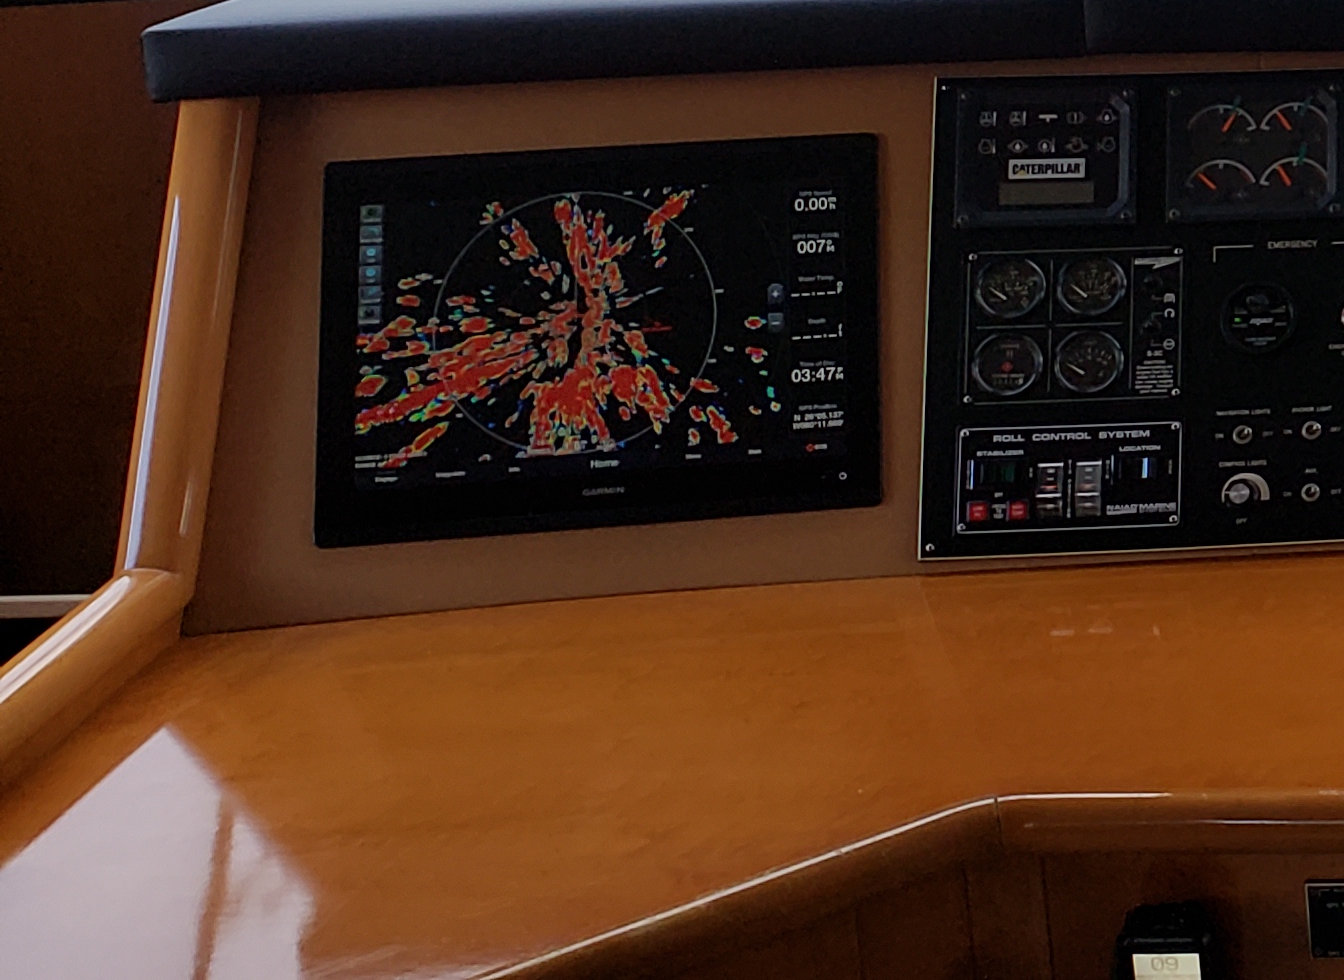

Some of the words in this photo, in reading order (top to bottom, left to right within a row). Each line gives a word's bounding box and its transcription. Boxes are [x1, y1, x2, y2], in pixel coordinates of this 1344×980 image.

[1012, 163, 1081, 175] CATERPILLAR
[790, 367, 835, 383] 03:47
[992, 434, 1026, 443] ROLL
[1031, 432, 1092, 442] CONTROL
[1098, 429, 1151, 440] SYSTEM
[1118, 444, 1162, 453] LOCATION
